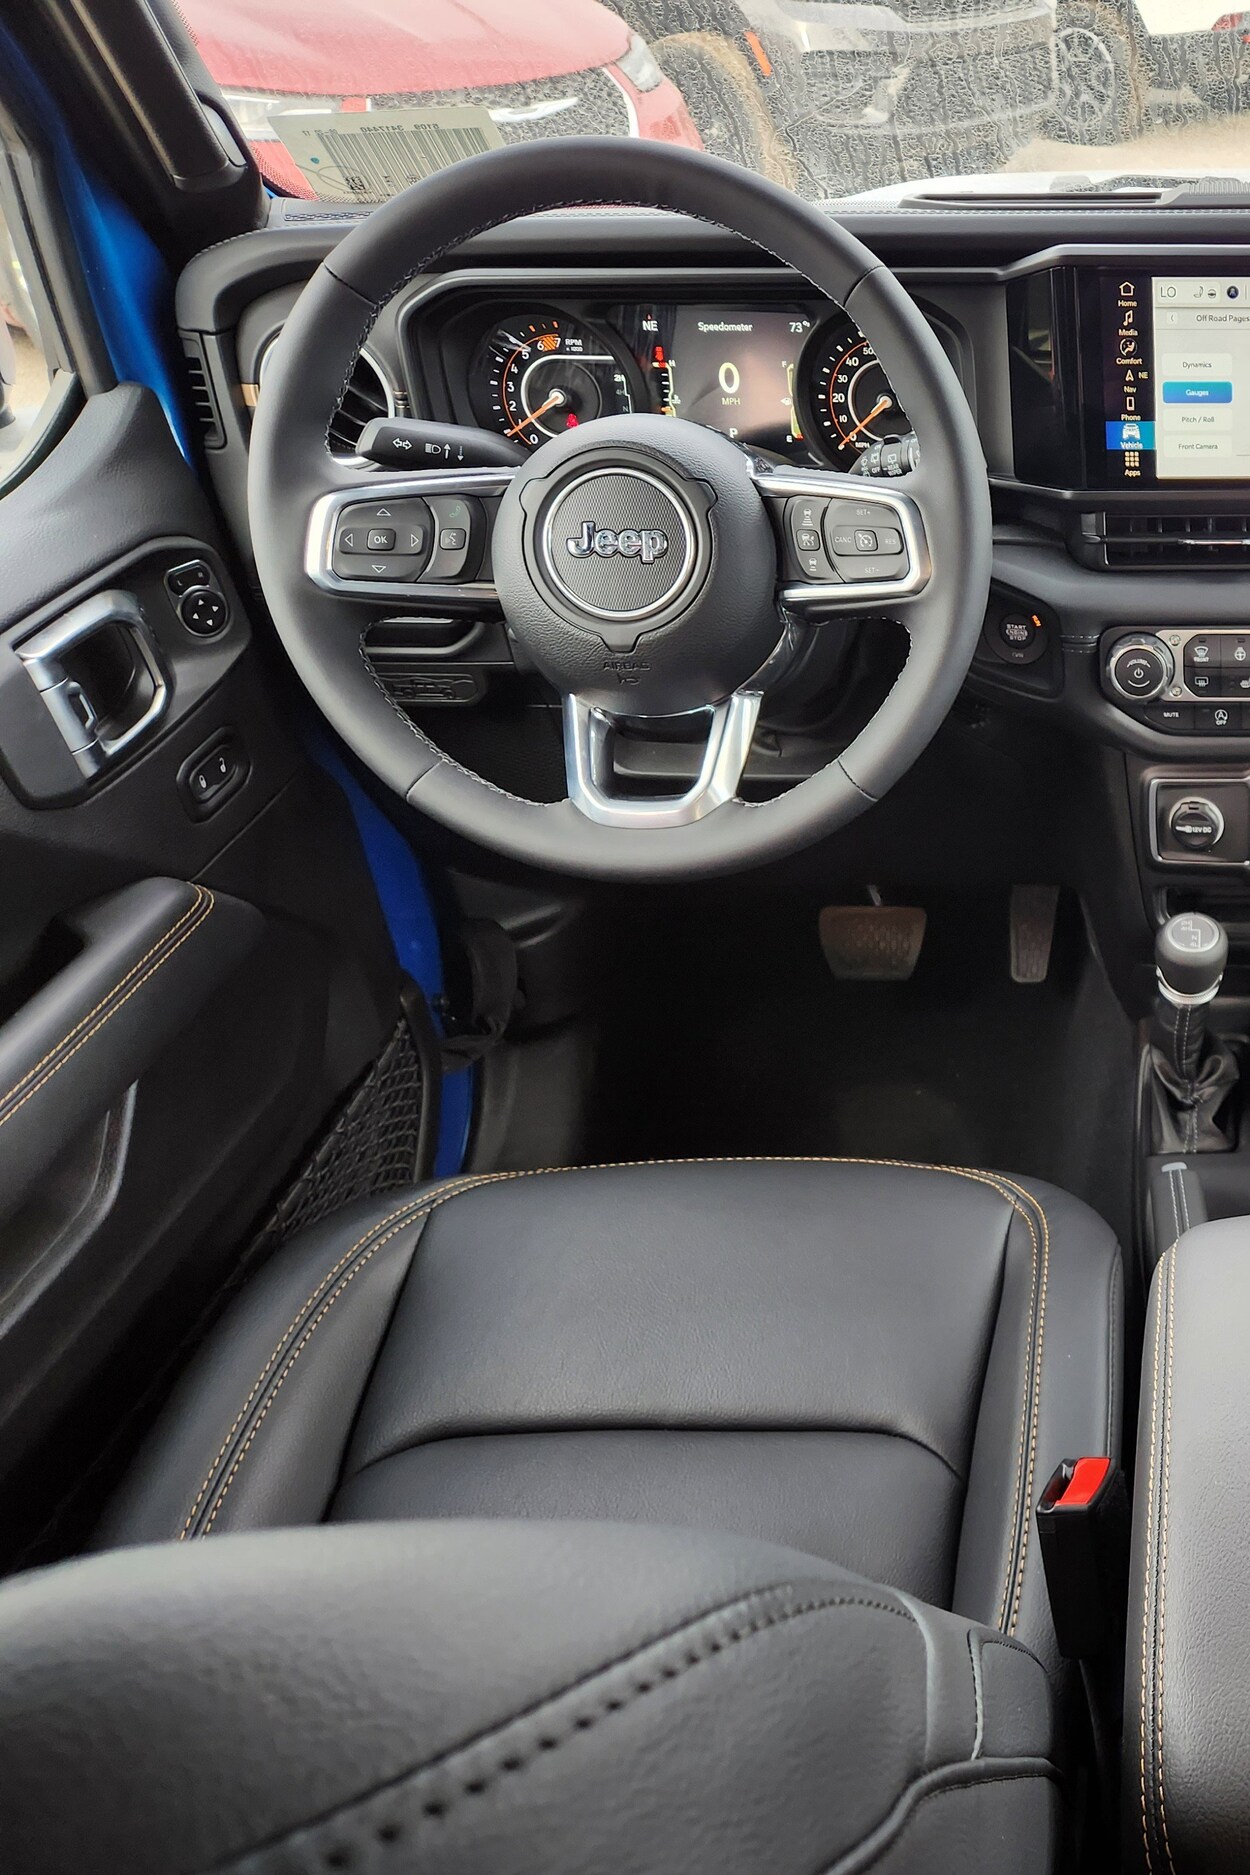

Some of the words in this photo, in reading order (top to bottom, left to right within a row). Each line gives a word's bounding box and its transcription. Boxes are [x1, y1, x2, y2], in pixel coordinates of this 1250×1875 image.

[1160, 286, 1177, 298] LO
[1209, 314, 1228, 322] Road
[1229, 315, 1250, 324] Pages
[642, 321, 658, 331] NE
[698, 322, 753, 333] Speedometer
[537, 341, 544, 350] 6
[554, 338, 561, 348] 7
[565, 338, 583, 346] RPM
[522, 350, 530, 359] 5
[846, 357, 859, 367] 40
[1116, 357, 1143, 365] Comfort
[1182, 361, 1212, 369] Dynamics
[511, 364, 518, 374] 4
[719, 362, 740, 394] 0
[837, 375, 848, 383] 30
[507, 382, 515, 392] 3
[833, 393, 845, 402] 20
[1185, 389, 1209, 397] Gauges
[509, 401, 517, 411] 2
[729, 428, 738, 438] P
[530, 434, 539, 444] 0
[1124, 469, 1140, 477] Apps
[373, 536, 388, 545] OK
[566, 521, 668, 564] Jeep
